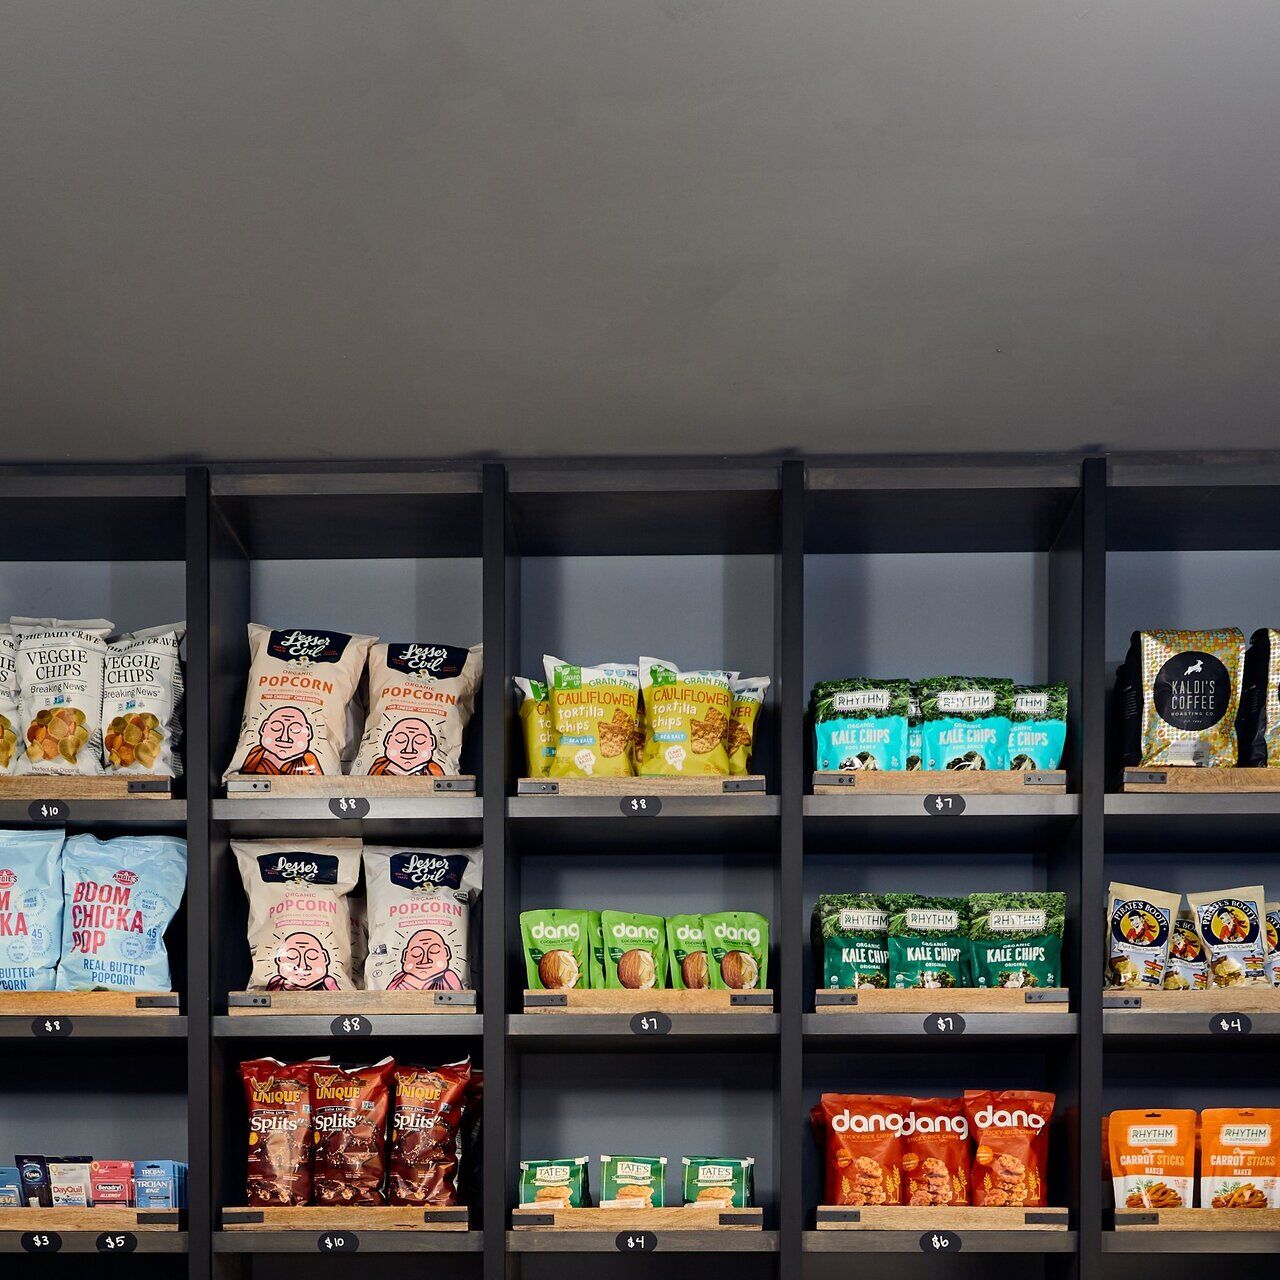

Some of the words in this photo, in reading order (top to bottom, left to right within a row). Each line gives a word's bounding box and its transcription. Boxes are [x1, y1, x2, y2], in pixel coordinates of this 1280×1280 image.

[72, 631, 101, 645] CRAVE
[281, 631, 330, 646] Lesser
[27, 649, 88, 665] VEGGIE
[399, 645, 447, 660] Lesser
[409, 658, 441, 671] Evil
[36, 664, 81, 680] CHIPS
[30, 683, 62, 694] Breaking
[259, 676, 333, 694] POPCORN
[405, 682, 435, 691] ORGANIC
[589, 678, 617, 688] GRAIN
[619, 678, 638, 690] FREE
[382, 687, 456, 705] POPCORN
[557, 691, 635, 708] CAULIFLOWER
[654, 689, 729, 707] CAULIFLOWER
[838, 693, 884, 705] RHYTHM
[1172, 695, 1214, 710] COFFEE
[558, 719, 590, 734] chips
[652, 716, 682, 728] chips
[832, 728, 856, 744] KALE
[860, 727, 890, 743] CHIPS
[939, 729, 964, 744] KALE
[967, 728, 996, 743] CHIPS
[340, 799, 356, 811] $8
[631, 799, 646, 810] $8
[936, 796, 952, 810] $7
[41, 806, 58, 816] $10
[402, 855, 449, 872] Lesser
[412, 870, 444, 883] Evil
[72, 881, 131, 906] BOOM
[270, 899, 337, 918] POPCORN
[389, 902, 462, 917] POPCORN
[1145, 901, 1168, 927] BOOTY
[1231, 900, 1257, 922] BOOTY
[72, 904, 143, 934] CHICKA
[911, 914, 952, 925] RHYTHM
[32, 928, 43, 939] 45
[532, 922, 580, 941] dang
[613, 923, 659, 944] dang
[715, 923, 760, 946] dang
[71, 930, 106, 954] POP
[842, 948, 866, 963] KALE
[907, 947, 932, 962] KALE
[1015, 947, 1045, 962] CHIPS
[0, 967, 35, 978] BUTTER
[83, 959, 107, 971] REAL
[109, 962, 145, 975] BUTTER
[44, 1020, 60, 1032] $8
[343, 1019, 360, 1032] $8
[641, 1018, 657, 1030] $7
[937, 1017, 952, 1031] $7
[1221, 1018, 1241, 1031] $4
[253, 1090, 300, 1103] UNIQUE
[317, 1087, 360, 1100] UNIQUE
[832, 1110, 904, 1137] dang
[1121, 1155, 1154, 1165] CARROT
[1157, 1155, 1184, 1165] STICKS
[1211, 1155, 1244, 1166] CARROT
[1247, 1156, 1275, 1166] STICKS
[539, 1167, 568, 1176] TATE'S
[33, 1235, 49, 1247] $3
[106, 1236, 125, 1248] $5
[325, 1237, 344, 1249] $10
[628, 1236, 644, 1248] $4
[932, 1235, 949, 1249] $6
